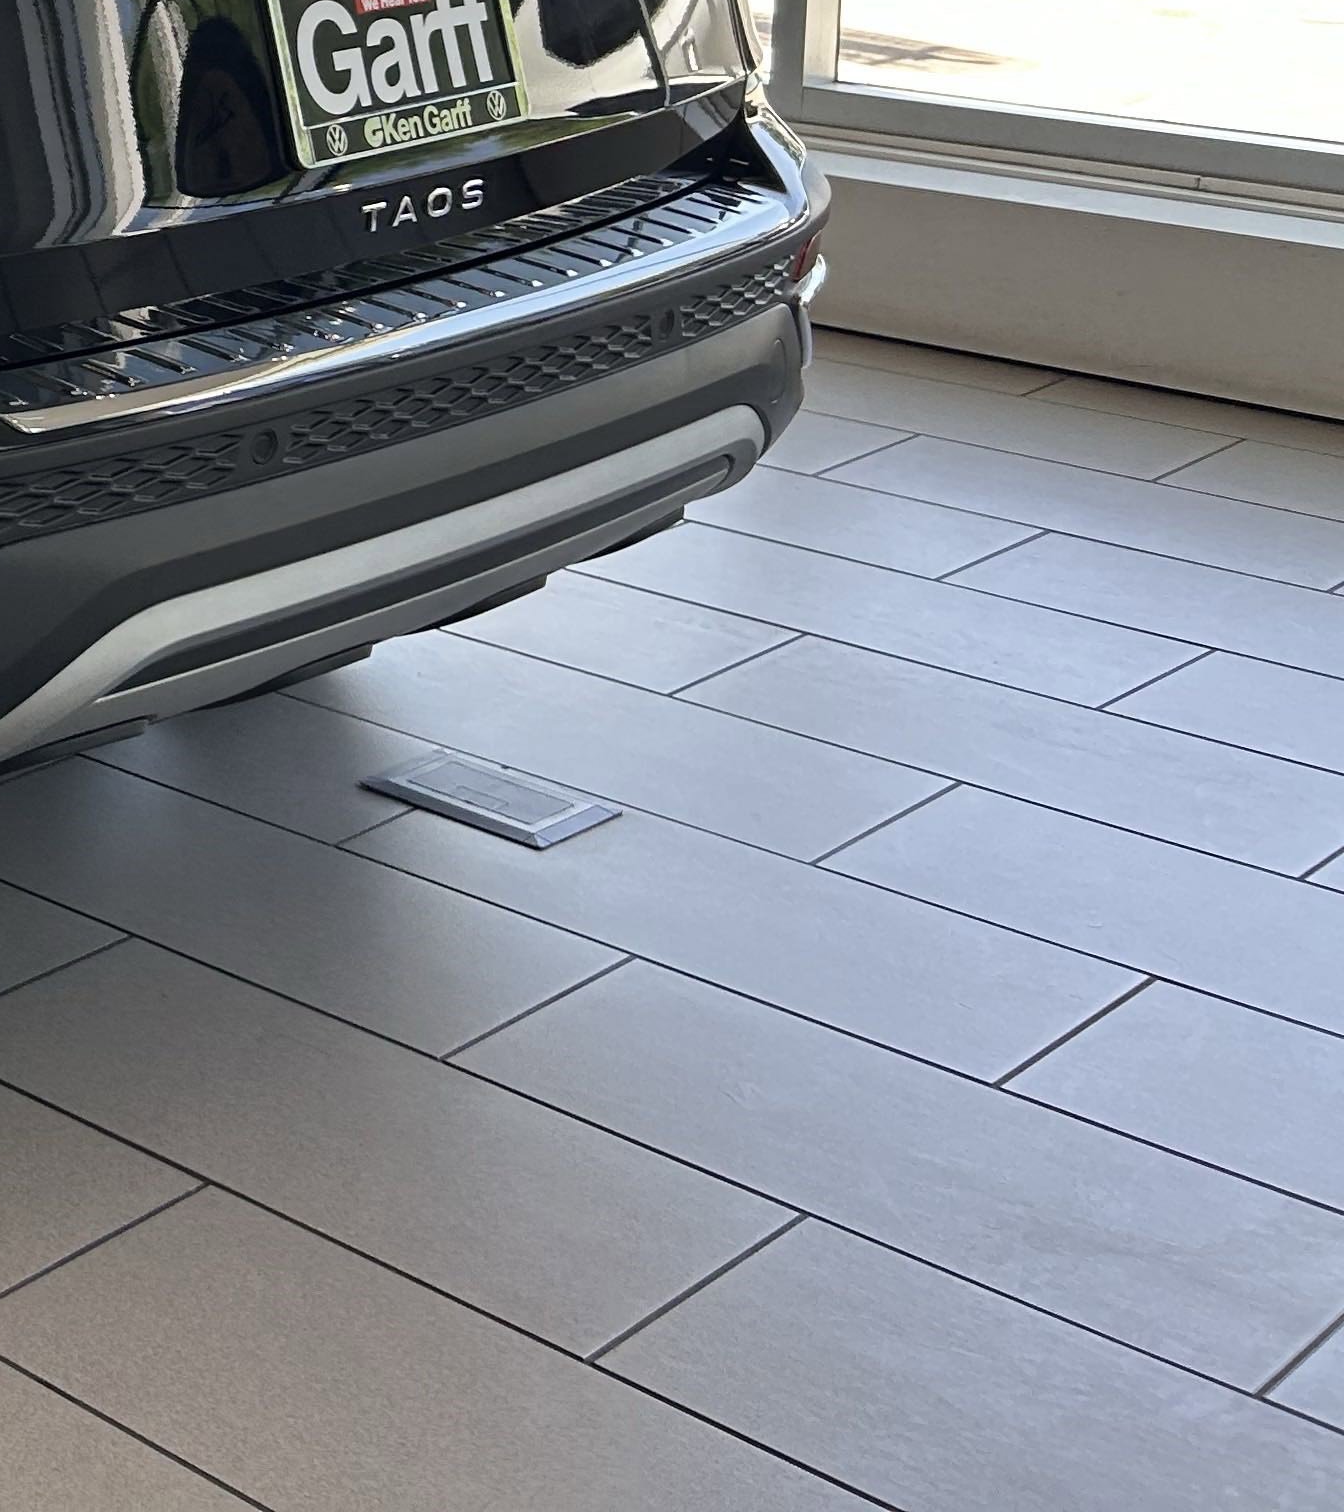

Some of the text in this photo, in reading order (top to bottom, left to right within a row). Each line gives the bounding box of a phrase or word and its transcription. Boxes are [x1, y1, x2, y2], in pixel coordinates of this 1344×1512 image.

[382, 113, 424, 145] Ken
[422, 98, 473, 135] Garff
[362, 178, 485, 232] TAOS
